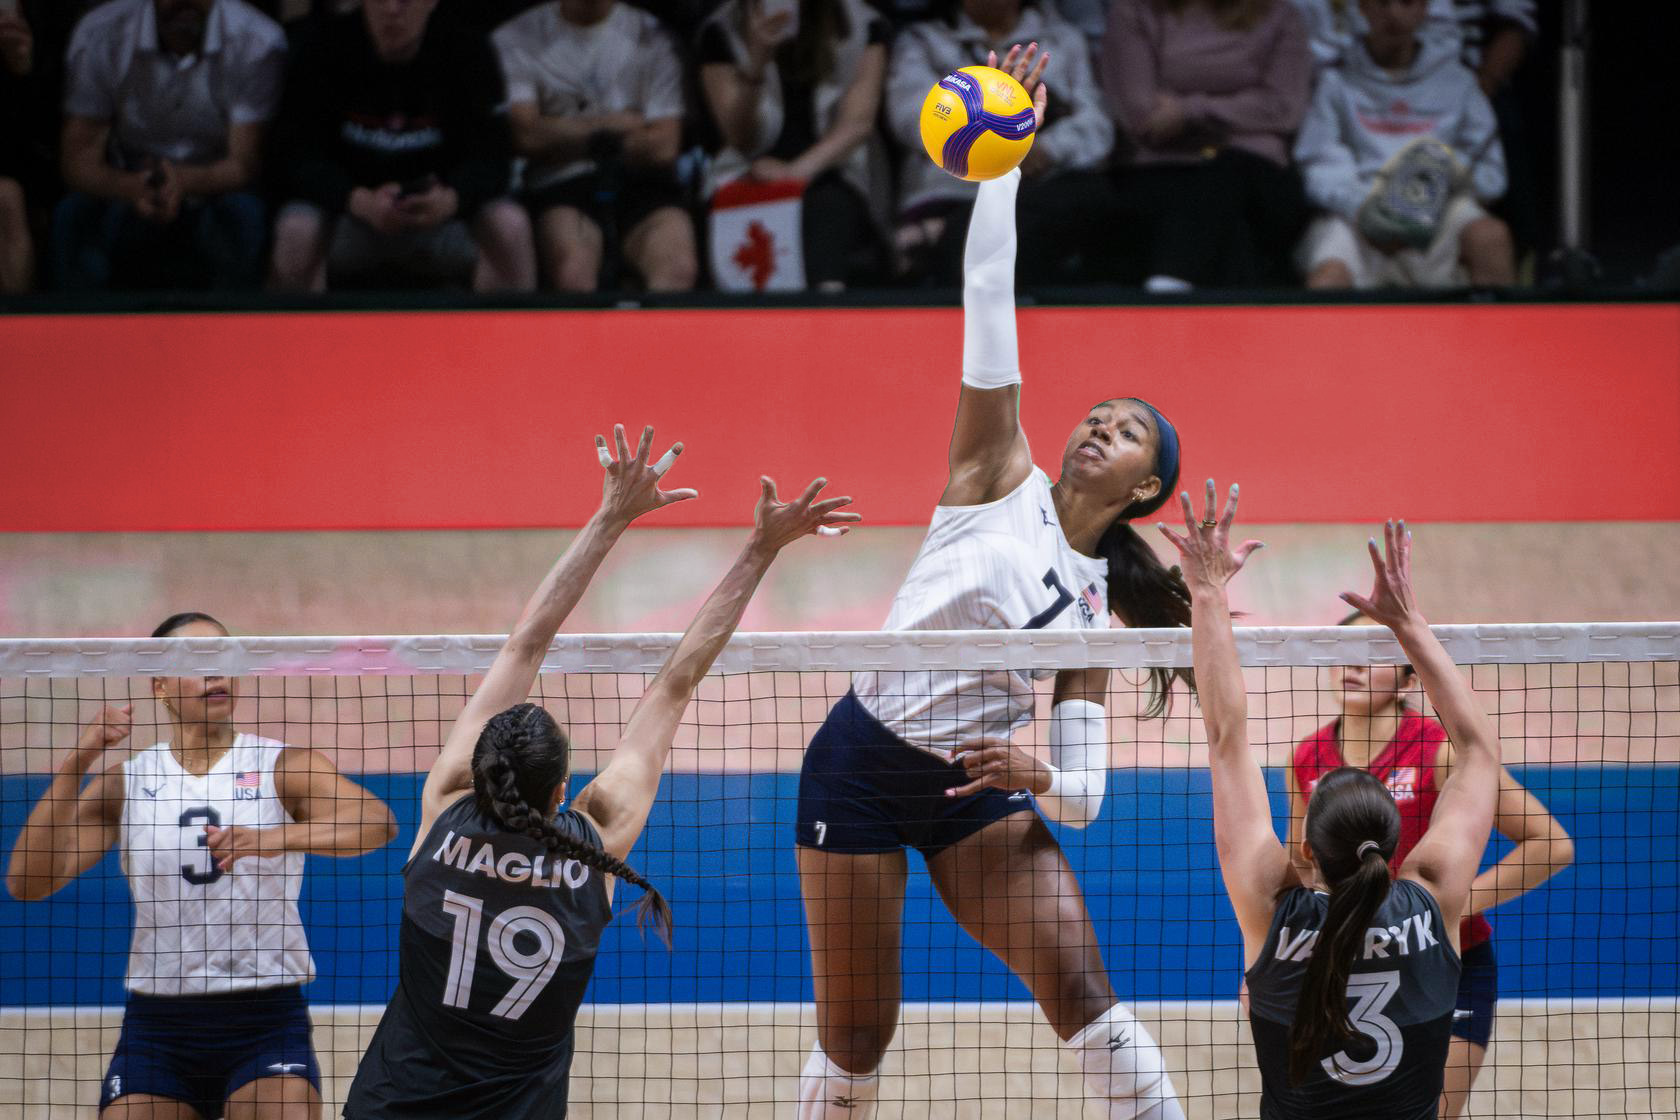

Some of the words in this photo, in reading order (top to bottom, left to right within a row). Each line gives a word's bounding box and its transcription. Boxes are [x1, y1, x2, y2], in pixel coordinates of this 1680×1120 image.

[935, 103, 952, 115] FIVB
[1020, 566, 1076, 629] 7
[234, 787, 263, 801] USA
[179, 806, 225, 885] 3
[432, 830, 590, 889] MAGLIO
[814, 820, 827, 845] 7
[442, 888, 566, 1021] 19
[1320, 969, 1404, 1086] 3
